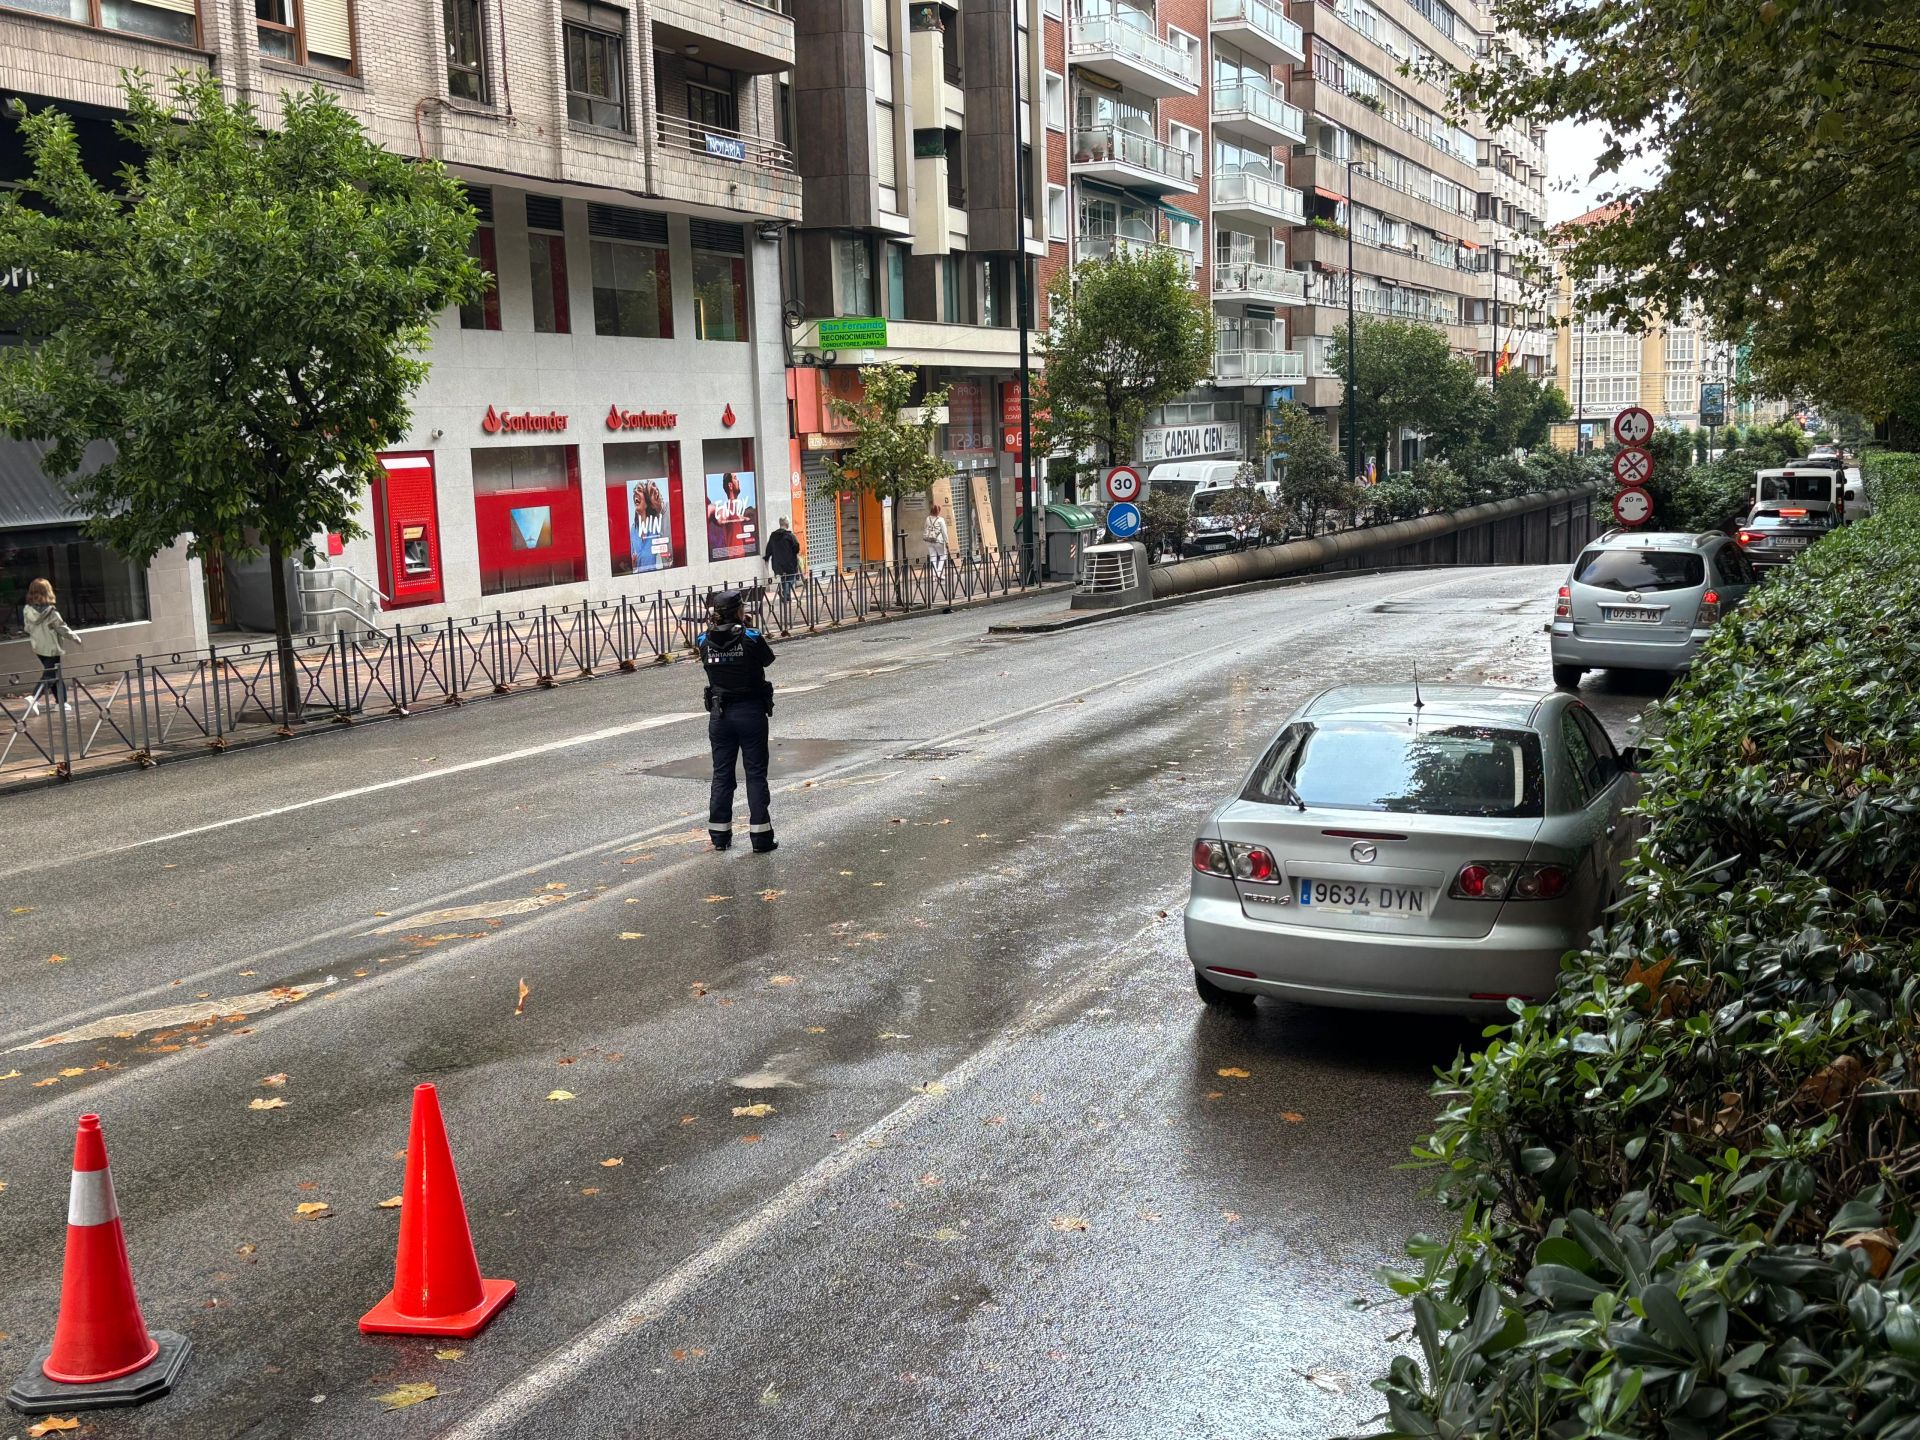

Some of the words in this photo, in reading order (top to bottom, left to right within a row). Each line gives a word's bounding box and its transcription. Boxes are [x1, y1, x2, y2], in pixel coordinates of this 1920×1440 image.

[821, 322, 839, 332] San
[842, 321, 883, 330] Fernando
[821, 332, 885, 342] RECONOCIMIENTOS
[501, 411, 569, 432] Santander
[621, 410, 678, 429] Santander
[1165, 429, 1200, 457] CADENA
[1204, 427, 1223, 453] CIEN
[1114, 479, 1132, 490] 30
[715, 496, 748, 520] ENJOY
[638, 514, 662, 538] WIN
[1613, 610, 1637, 618] 0795
[1640, 611, 1658, 620] FVK
[1315, 883, 1370, 907] 9634
[1380, 888, 1423, 911] DYN
